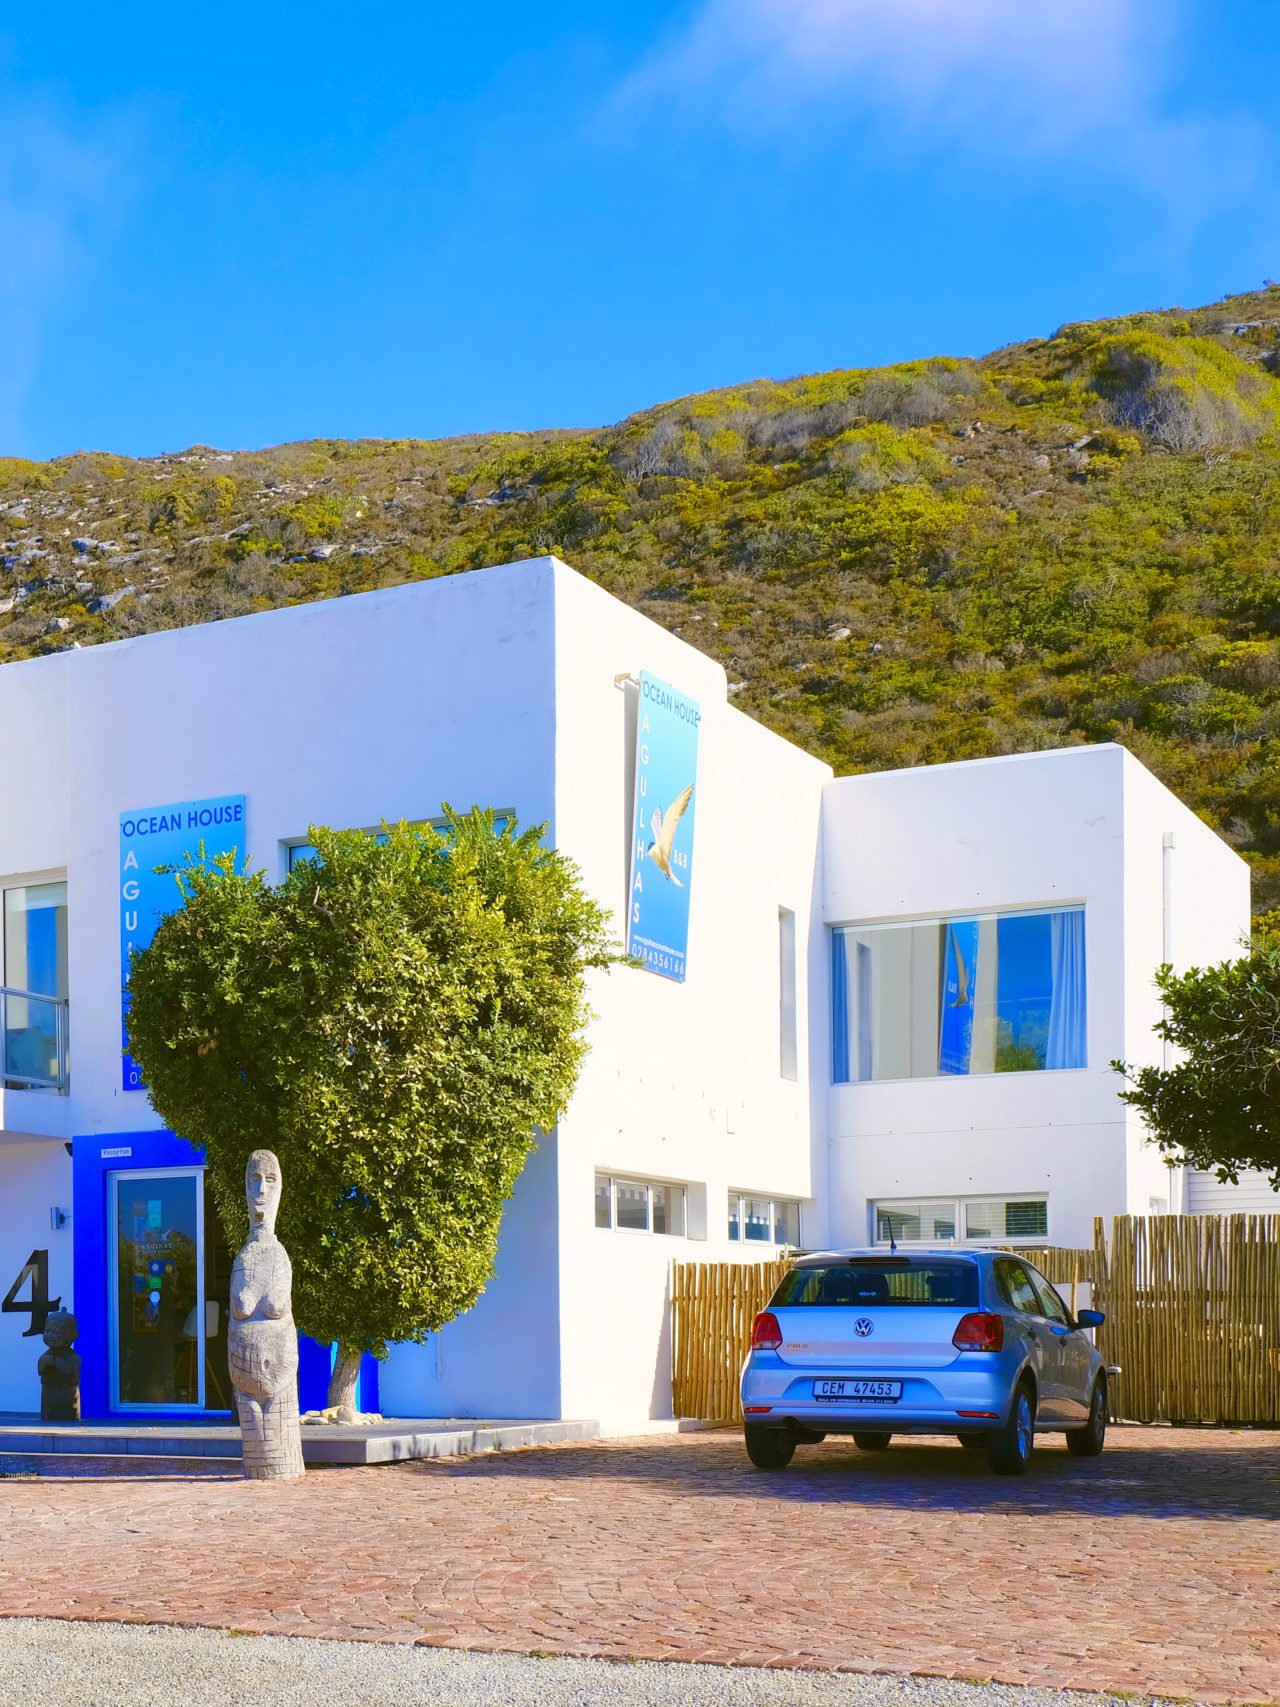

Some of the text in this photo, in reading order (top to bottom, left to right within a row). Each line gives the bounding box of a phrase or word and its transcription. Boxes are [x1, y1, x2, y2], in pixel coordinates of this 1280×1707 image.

[642, 680, 699, 728] OCEAN HOUSE
[122, 804, 242, 838] OCEAN HOUSE
[633, 713, 650, 924] AGULHAS
[673, 848, 688, 869] B&B
[1, 1249, 61, 1337] 4
[822, 1382, 893, 1395] CEM 47453
